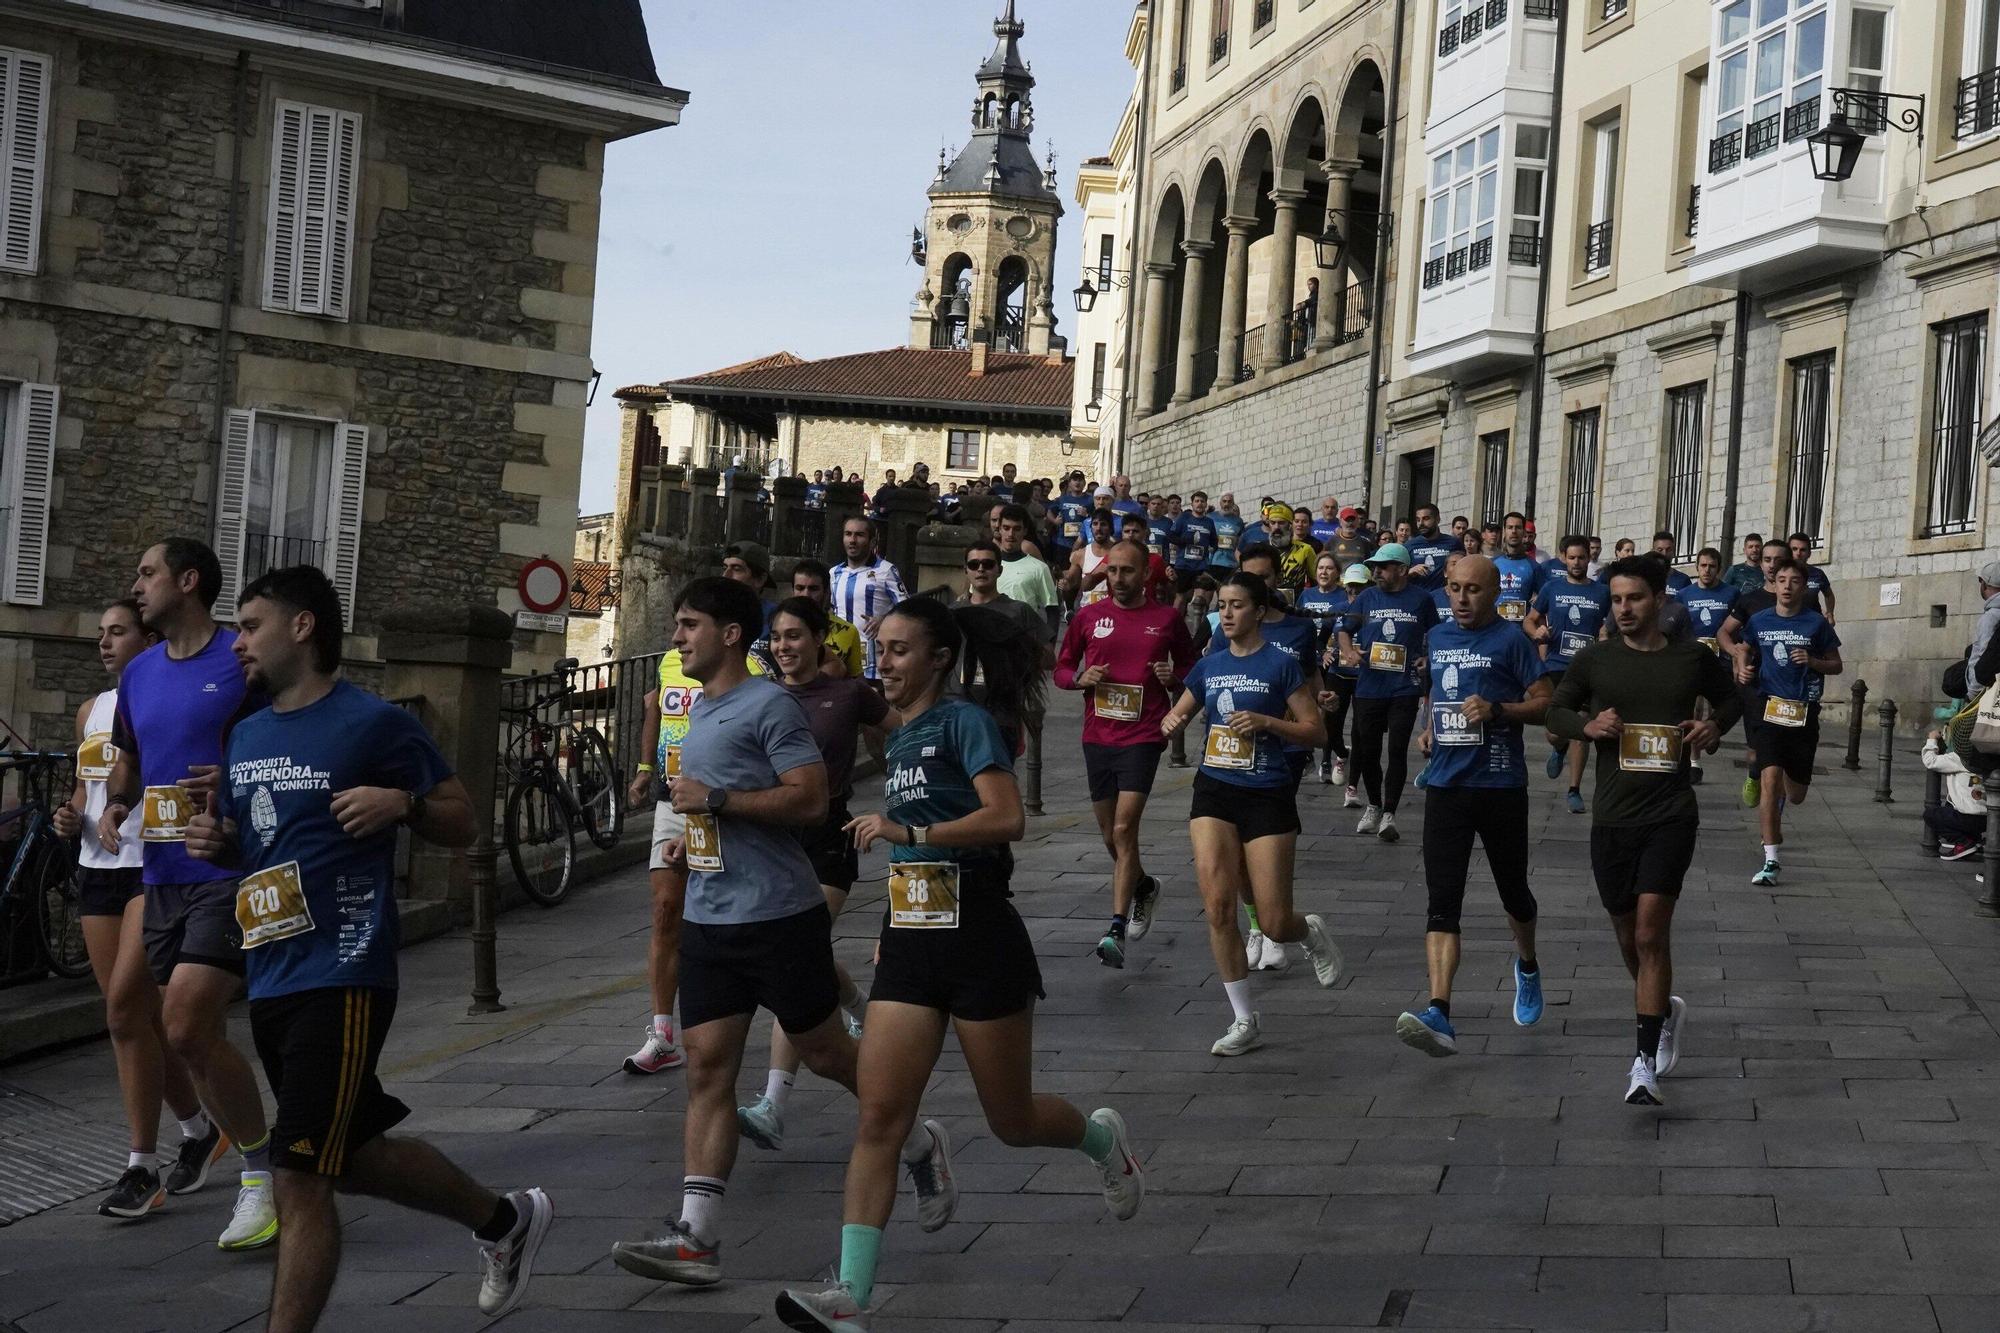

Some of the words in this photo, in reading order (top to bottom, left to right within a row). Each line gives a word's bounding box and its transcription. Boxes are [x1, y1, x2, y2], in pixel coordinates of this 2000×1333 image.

[1506, 605, 1519, 614] 150
[1380, 650, 1397, 661] 374
[1436, 653, 1481, 663] ALMENDRA
[1437, 648, 1470, 657] CONQUISTA
[1209, 678, 1260, 690] ALMENDRA
[1210, 674, 1247, 682] CONQUISTA
[1107, 692, 1129, 707] 521
[1776, 703, 1797, 717] 355
[1441, 712, 1467, 730] 948
[1215, 736, 1240, 754] 425
[1639, 735, 1669, 754] 614
[235, 756, 292, 772] CONQUISTA
[235, 765, 313, 786] ALMENDRA
[273, 779, 331, 792] KONKISTA
[900, 786, 929, 805] TRAIL
[157, 799, 178, 821] 60
[688, 826, 706, 849] 213
[907, 878, 929, 904] 38
[247, 885, 281, 918] 120
[289, 1145, 315, 1156] adidas
